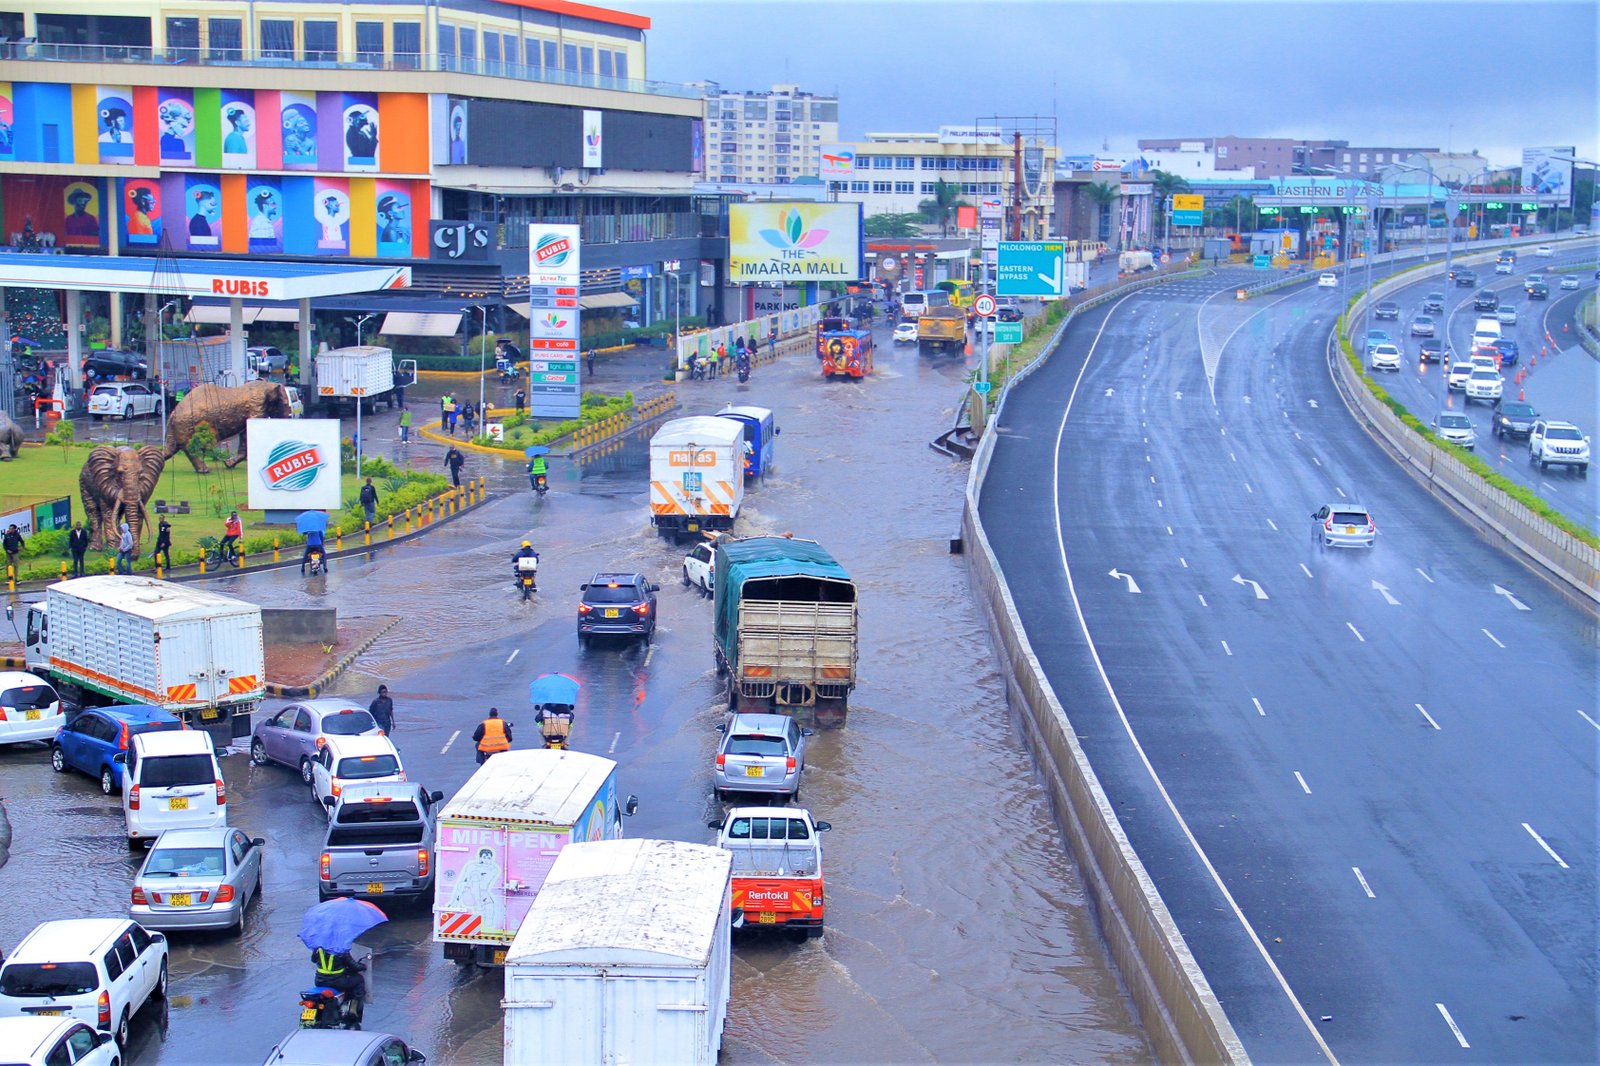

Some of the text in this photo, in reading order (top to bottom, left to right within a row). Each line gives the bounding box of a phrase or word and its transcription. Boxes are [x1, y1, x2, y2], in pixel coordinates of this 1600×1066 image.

[1277, 186, 1331, 196] EASTERN
[782, 250, 805, 258] THE
[741, 262, 848, 274] IMAARA MALL
[979, 301, 991, 311] 40
[55, 514, 68, 524] BANK
[748, 891, 789, 899] Rentokil
